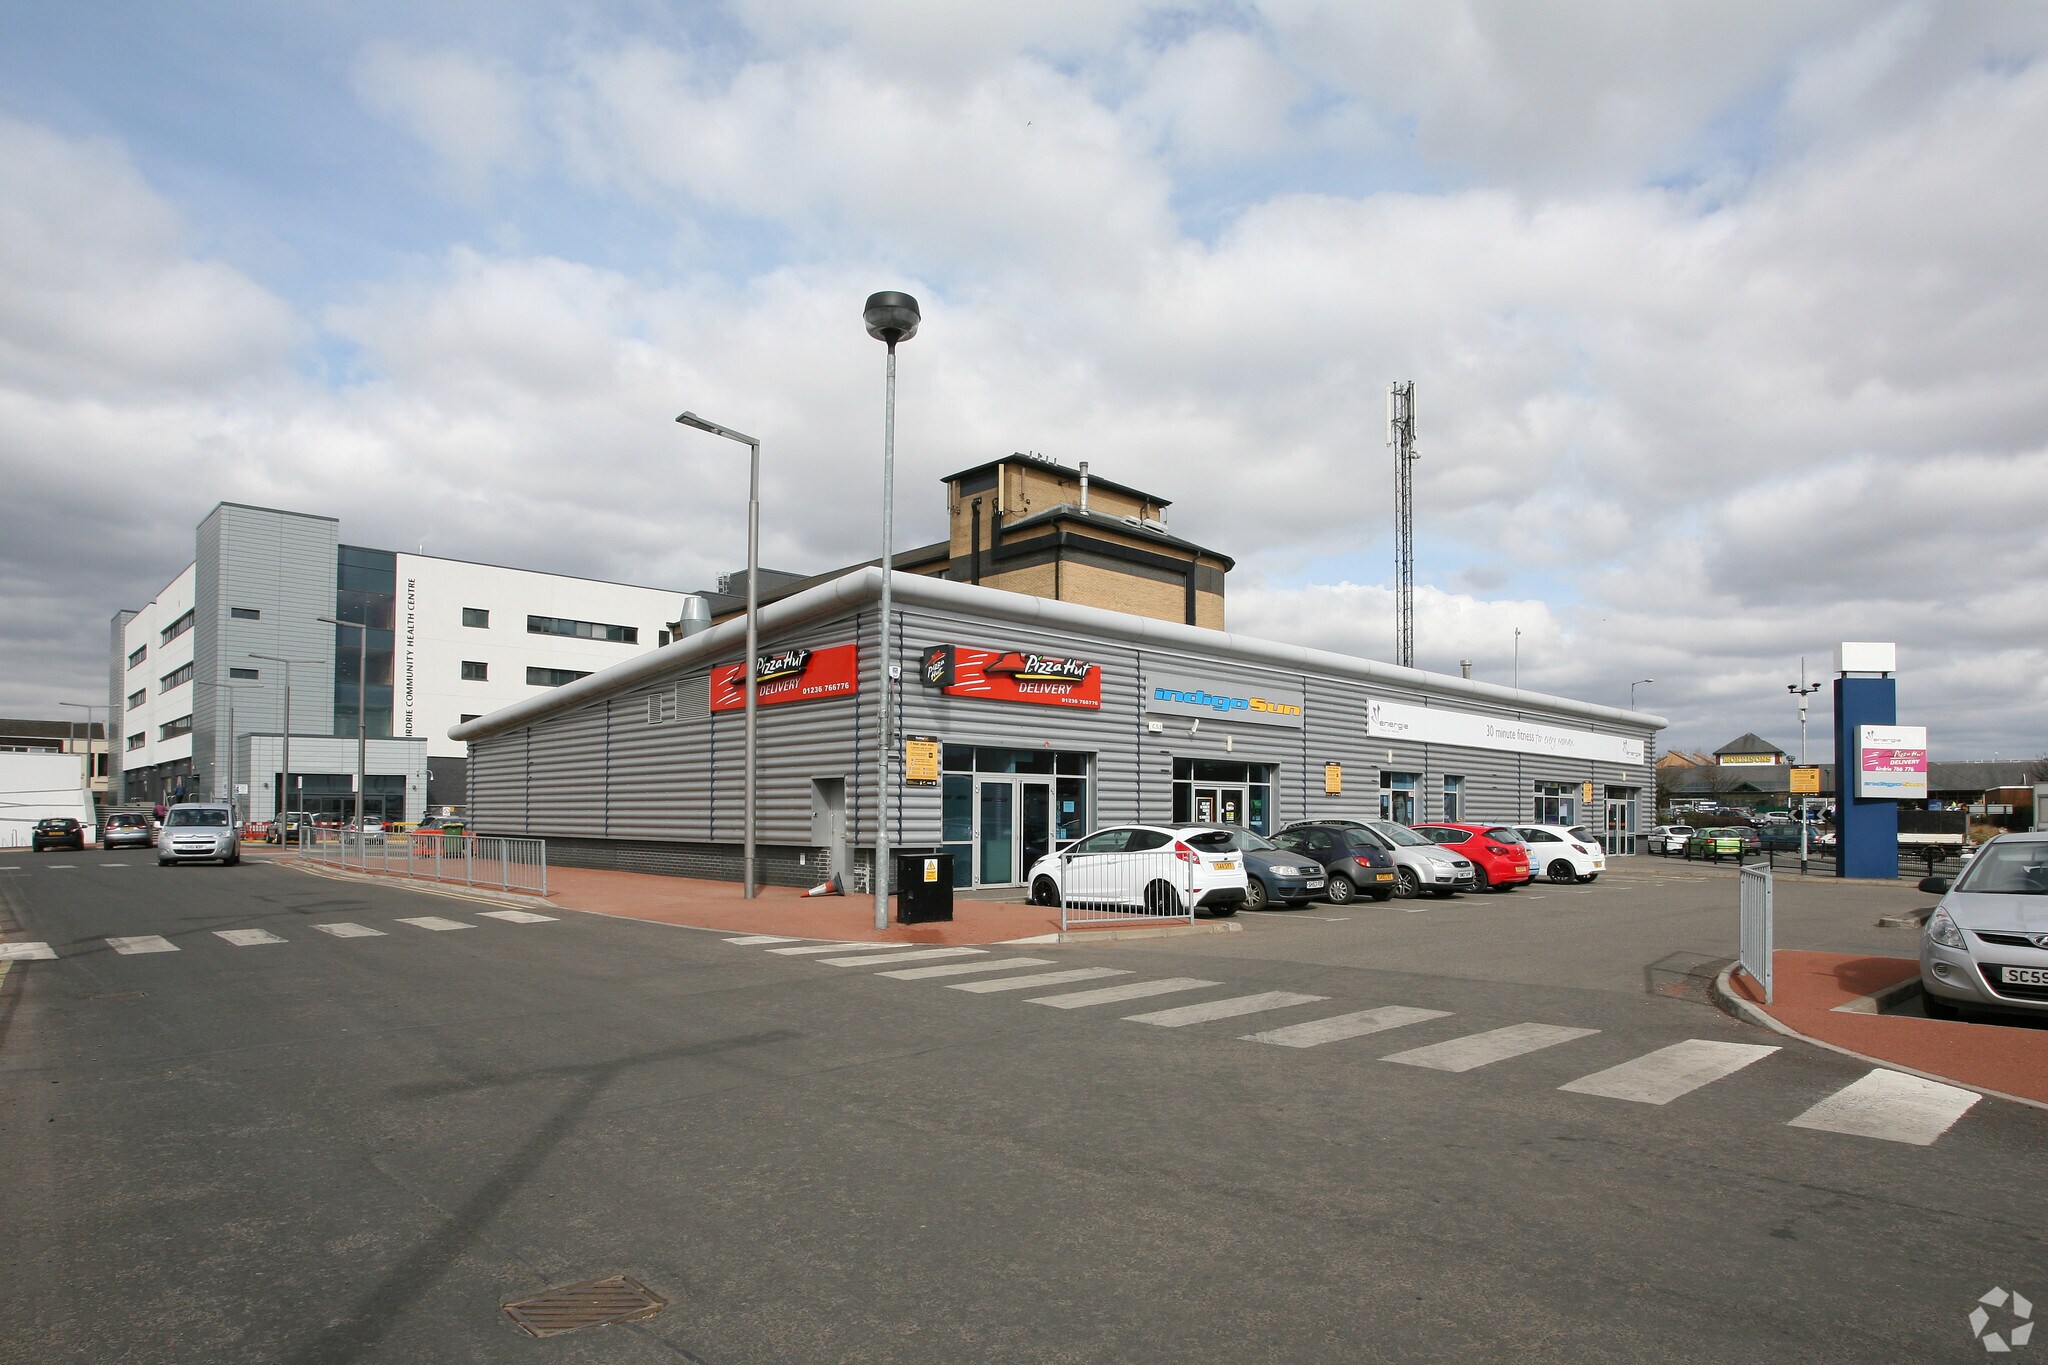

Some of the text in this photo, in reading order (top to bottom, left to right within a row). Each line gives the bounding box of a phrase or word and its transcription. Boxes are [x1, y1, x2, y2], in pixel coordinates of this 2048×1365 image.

[405, 577, 416, 737] IRDRIE COMMUNITY HEALTH CENTRE
[756, 651, 808, 674] Pizza Hut
[1024, 654, 1092, 677] Pizza Hut
[927, 660, 945, 678] Pizza
[931, 667, 943, 681] Hut
[759, 678, 801, 697] DELIVERY
[802, 681, 850, 695] 01236 766776
[1018, 682, 1073, 695] DELIVERY
[1486, 724, 1495, 738] 30
[1495, 729, 1516, 740] minute
[1516, 728, 1535, 742] fitness
[1723, 755, 1772, 764] MORRISONS
